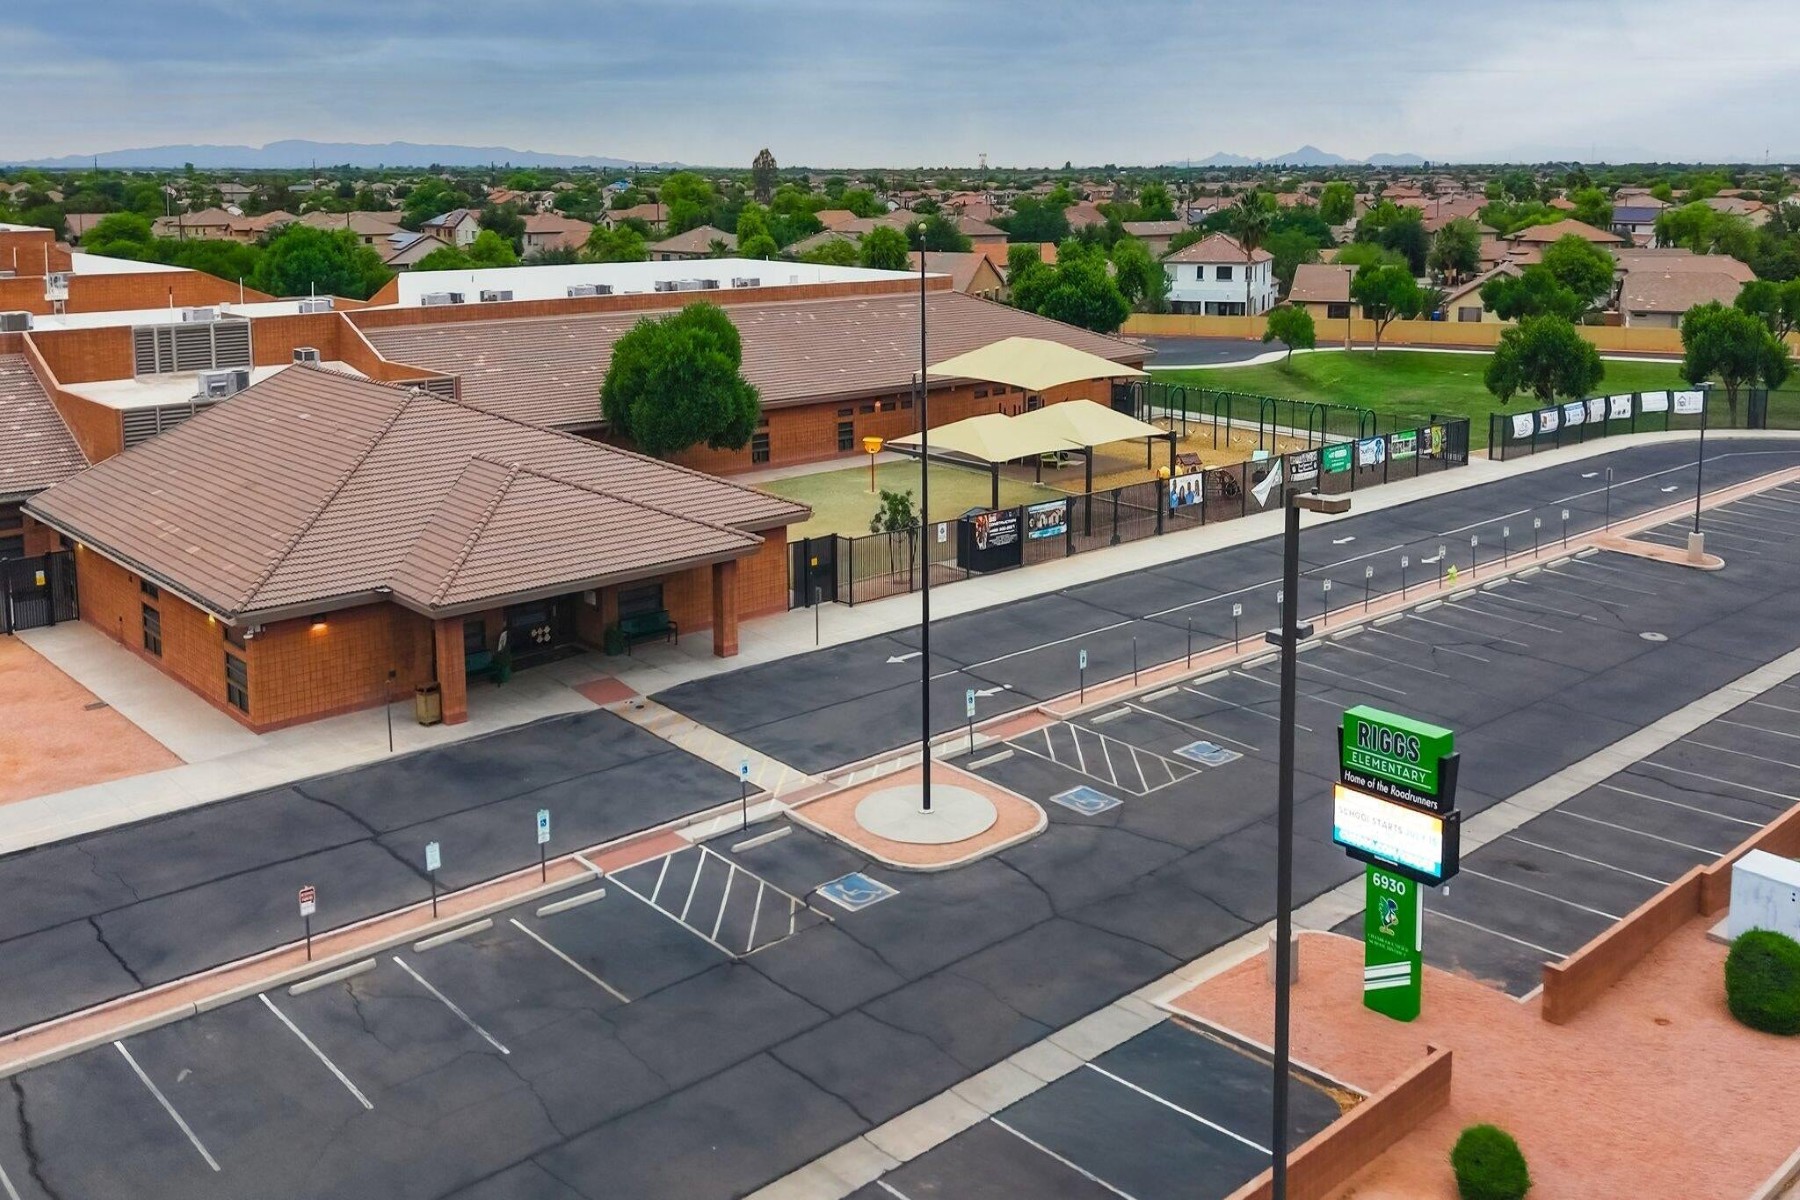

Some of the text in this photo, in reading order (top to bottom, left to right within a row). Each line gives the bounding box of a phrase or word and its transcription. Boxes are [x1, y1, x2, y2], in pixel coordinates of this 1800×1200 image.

[1357, 720, 1420, 763] RIGGS
[1352, 751, 1426, 783] ELEMENTARY
[1344, 770, 1438, 810] Home of the Roadrunners
[1338, 805, 1370, 822] SCHOOL
[1372, 817, 1404, 835] STARTS
[1372, 872, 1406, 896] 6930
